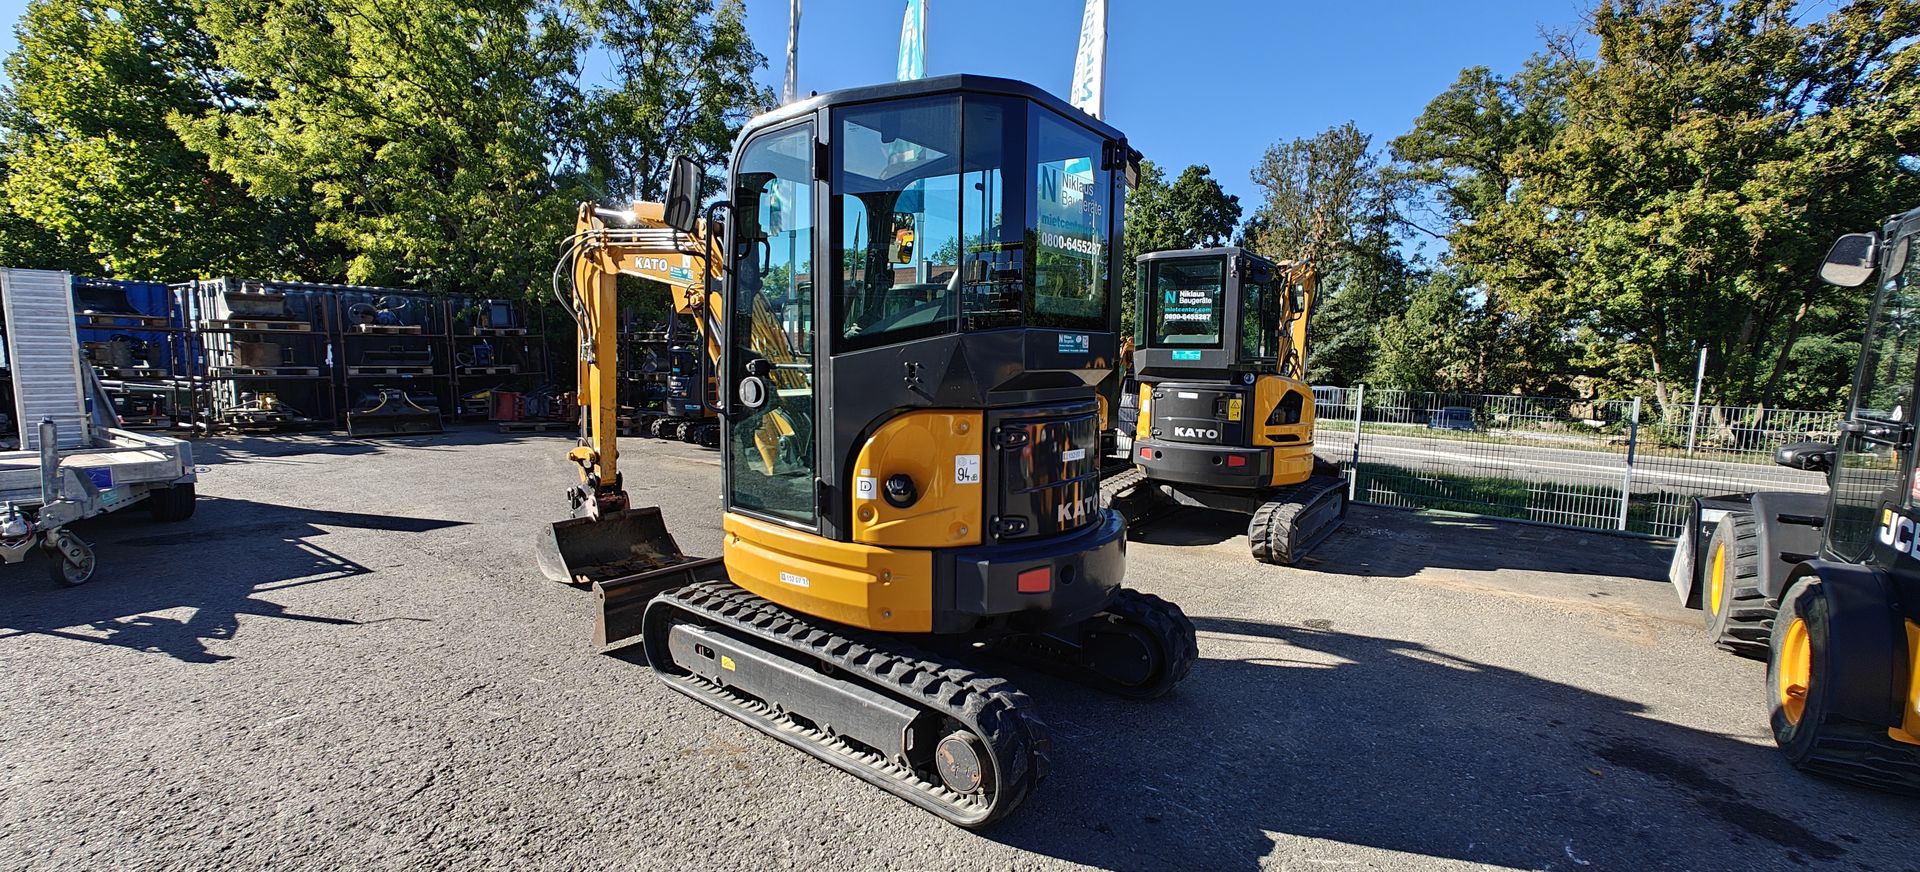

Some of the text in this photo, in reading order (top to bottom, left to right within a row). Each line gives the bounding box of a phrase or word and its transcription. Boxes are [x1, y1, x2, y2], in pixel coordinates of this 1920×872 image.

[1042, 165, 1056, 202] N
[1062, 173, 1094, 196] Niklaus
[1041, 231, 1101, 256] 0800-6455287
[634, 256, 668, 272] KATO
[1165, 290, 1176, 304] N
[1179, 290, 1205, 298] Niklaus
[1179, 297, 1212, 305] Baugeräte
[1174, 426, 1218, 439] KATO
[957, 467, 970, 482] 94
[1057, 492, 1099, 523] KATO
